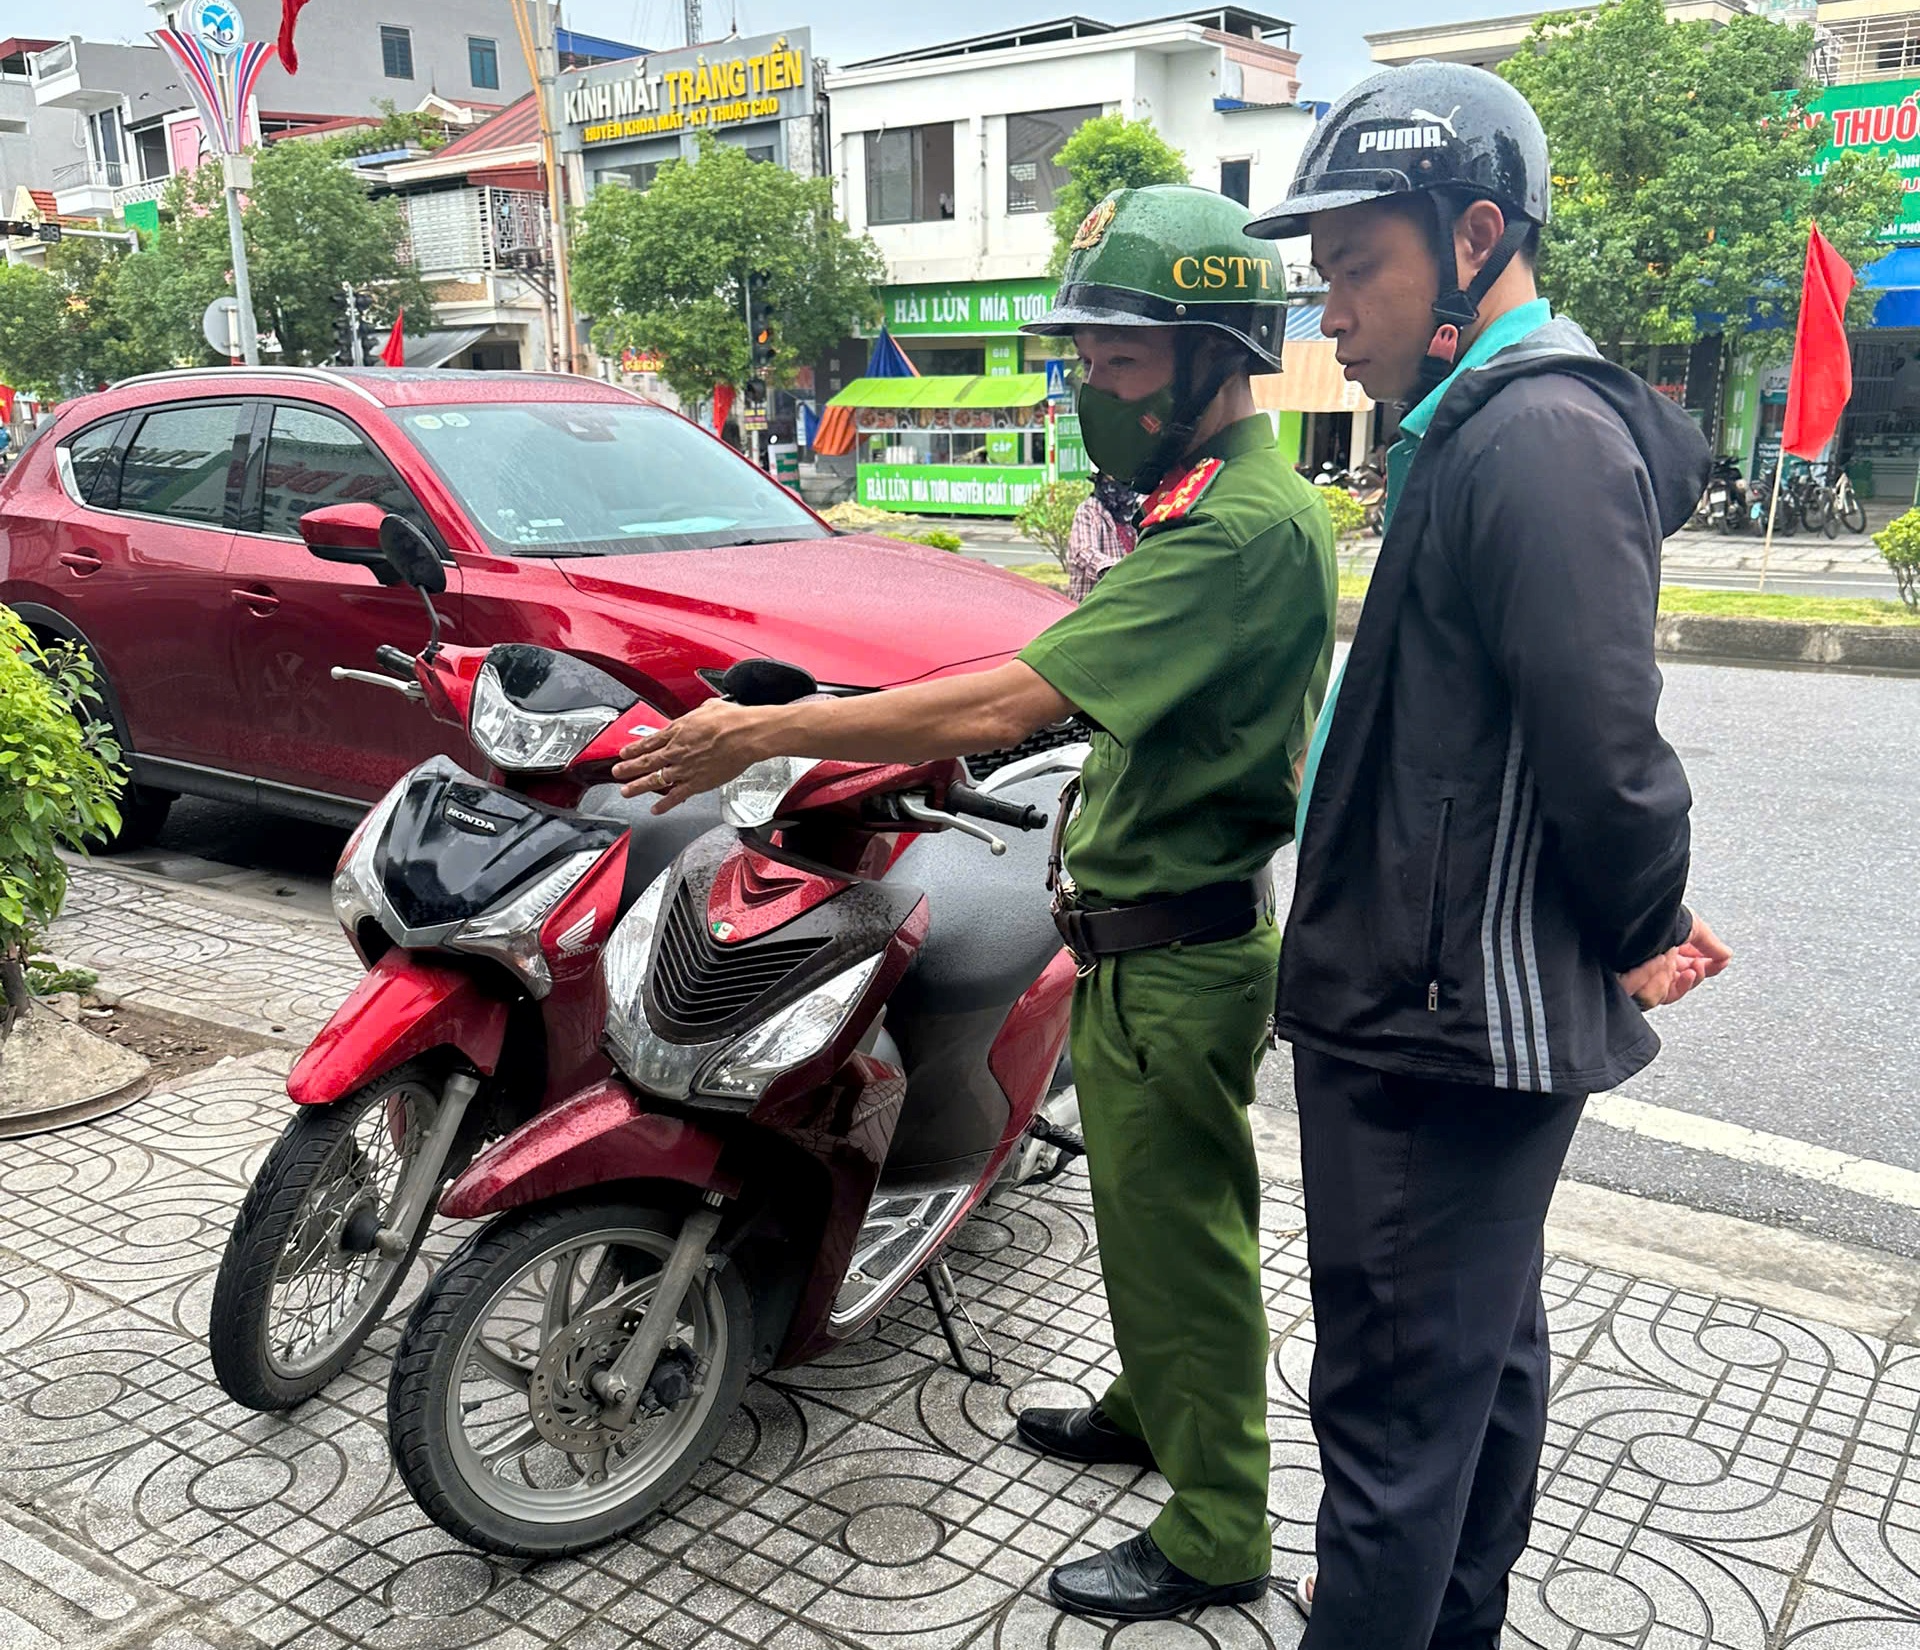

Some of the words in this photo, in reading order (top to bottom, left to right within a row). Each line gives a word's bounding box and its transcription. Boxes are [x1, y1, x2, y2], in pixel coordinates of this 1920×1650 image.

[564, 78, 612, 124] KÍNH
[614, 57, 662, 116] MẮT
[664, 54, 747, 107] TRÀNG
[747, 36, 804, 94] TIỀN
[624, 117, 657, 136] KHOA
[709, 101, 750, 122] THUẬT
[751, 96, 779, 117] CAO
[1832, 89, 1920, 147] THUỐ
[1173, 255, 1273, 290] CSTT
[932, 290, 969, 323] LÙN
[979, 292, 1009, 321] MÍA
[447, 807, 497, 832] HONDA
[557, 942, 600, 960] HONDA
